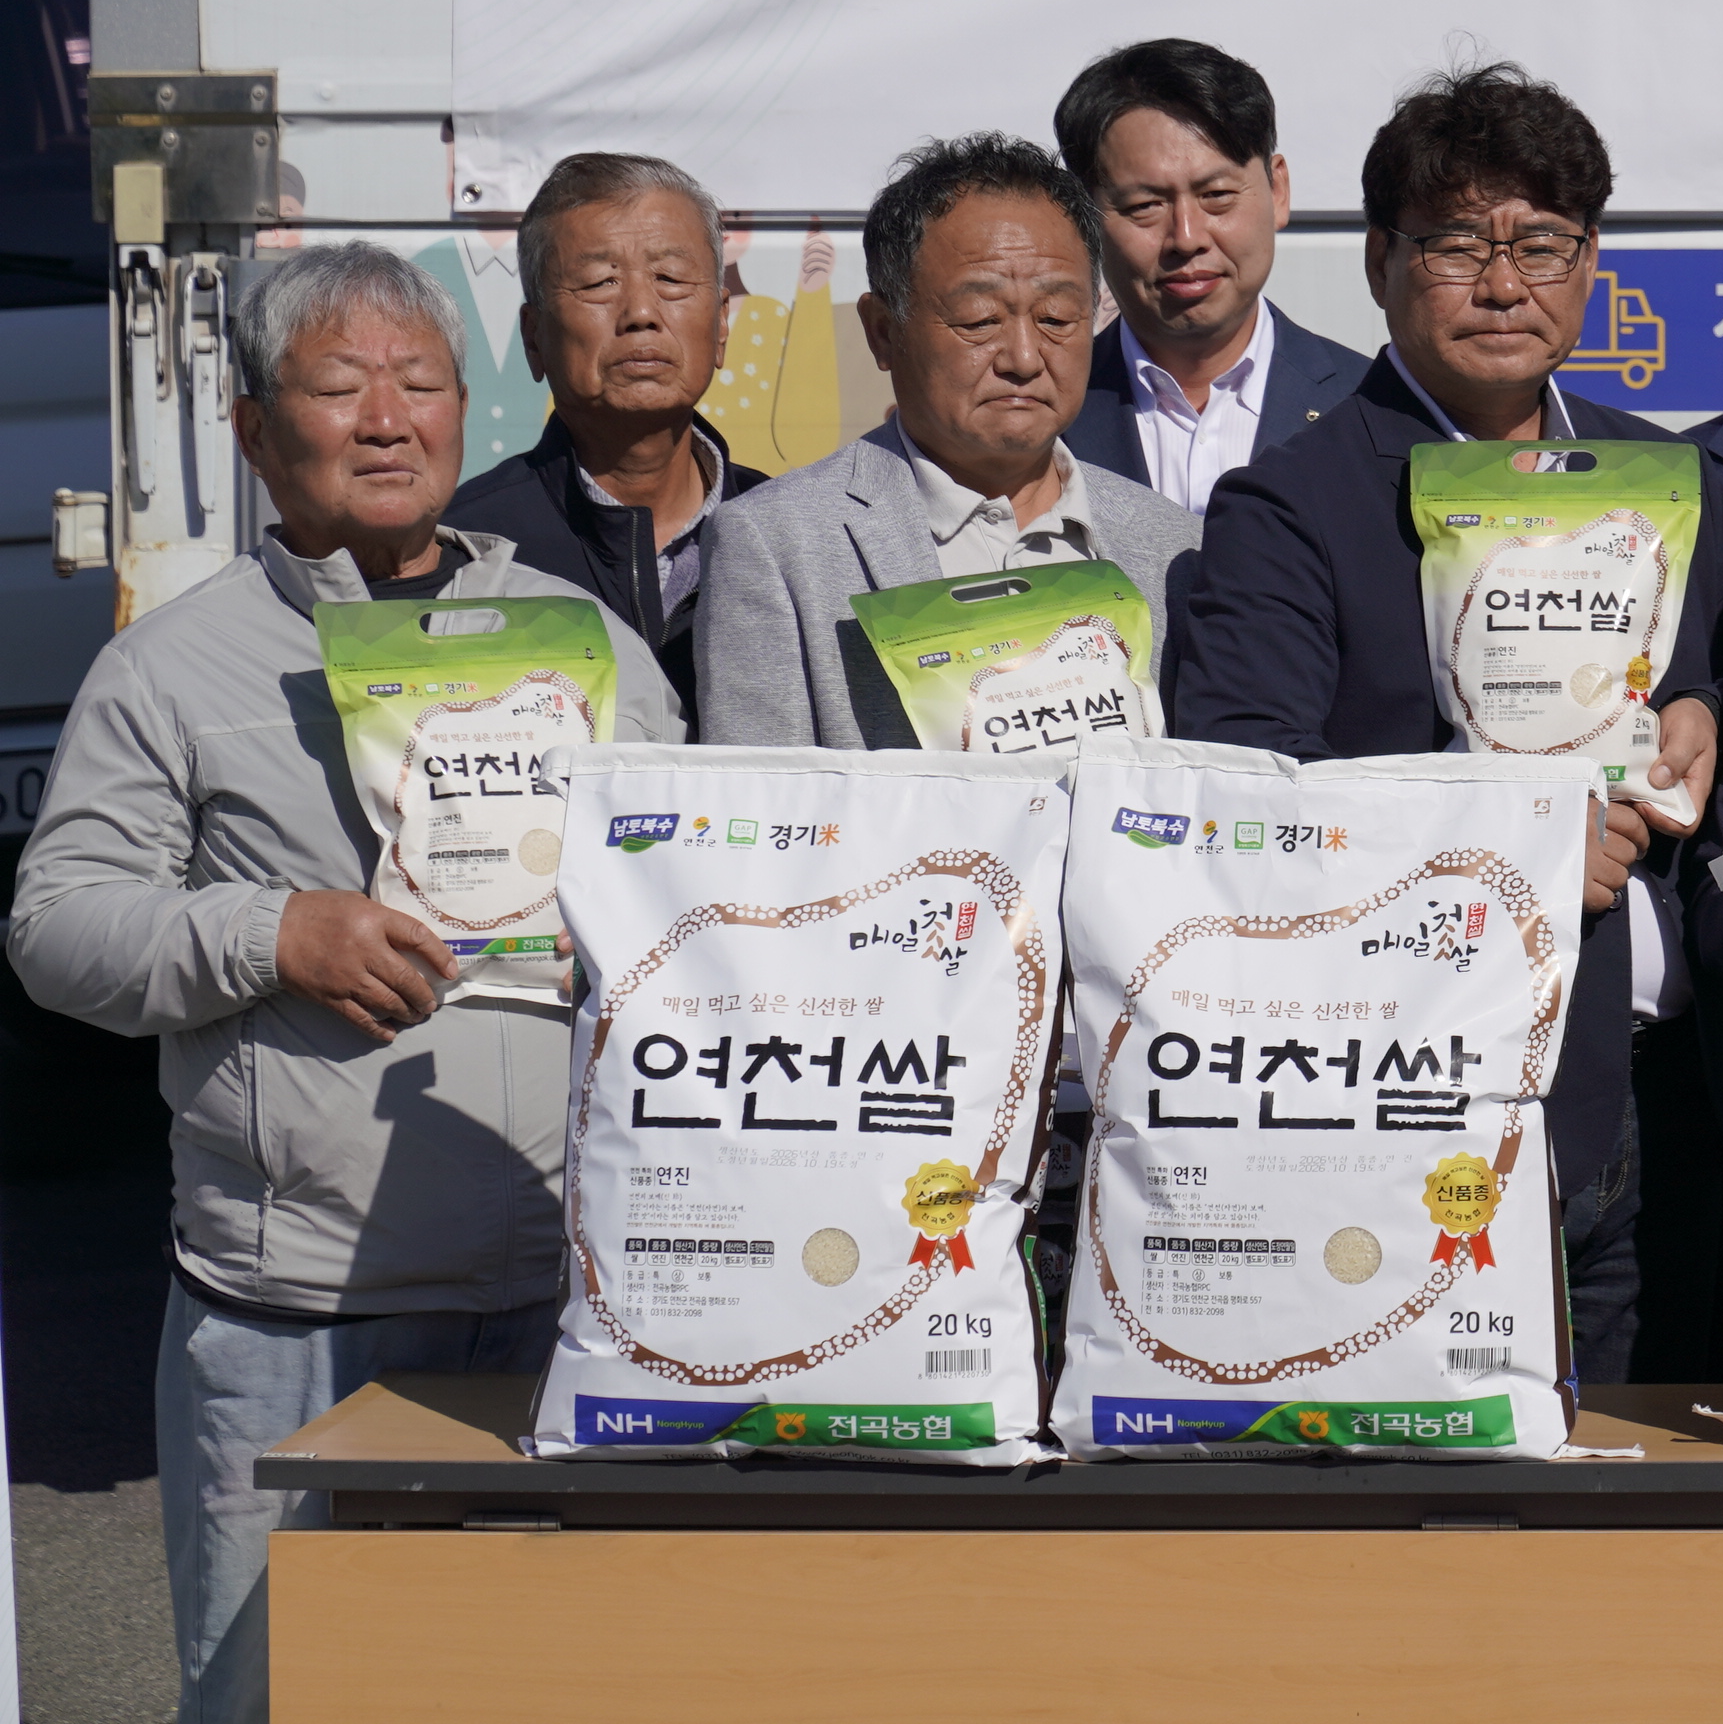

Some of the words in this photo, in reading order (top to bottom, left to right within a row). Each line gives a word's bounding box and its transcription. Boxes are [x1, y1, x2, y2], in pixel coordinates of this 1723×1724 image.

[1485, 589, 1636, 634] 연천쌀
[613, 815, 673, 839] 남토북수
[1120, 811, 1184, 836] 남토북수
[769, 823, 840, 850] 경기米
[1275, 823, 1348, 853] 경기米
[663, 995, 700, 1017] 매일
[707, 996, 740, 1016] 먹고
[749, 994, 789, 1015] 싶은
[797, 996, 857, 1017] 신선한
[865, 996, 884, 1016] 쌀
[632, 1033, 967, 1136] 연천쌀
[1148, 1031, 1481, 1131] 연천쌀
[656, 1165, 689, 1186] 연진
[1173, 1165, 1207, 1186] 연진
[1436, 1183, 1489, 1203] 신품종
[1250, 1296, 1262, 1304] 557
[928, 1313, 958, 1336] 20
[966, 1313, 992, 1338] kg
[1449, 1311, 1480, 1335] 20
[1488, 1312, 1513, 1336] kg
[596, 1411, 653, 1434] NH
[656, 1419, 704, 1430] NongHyup
[828, 1413, 952, 1440] 전곡농협
[1116, 1411, 1173, 1434] NH
[1350, 1411, 1473, 1438] 전곡농협
